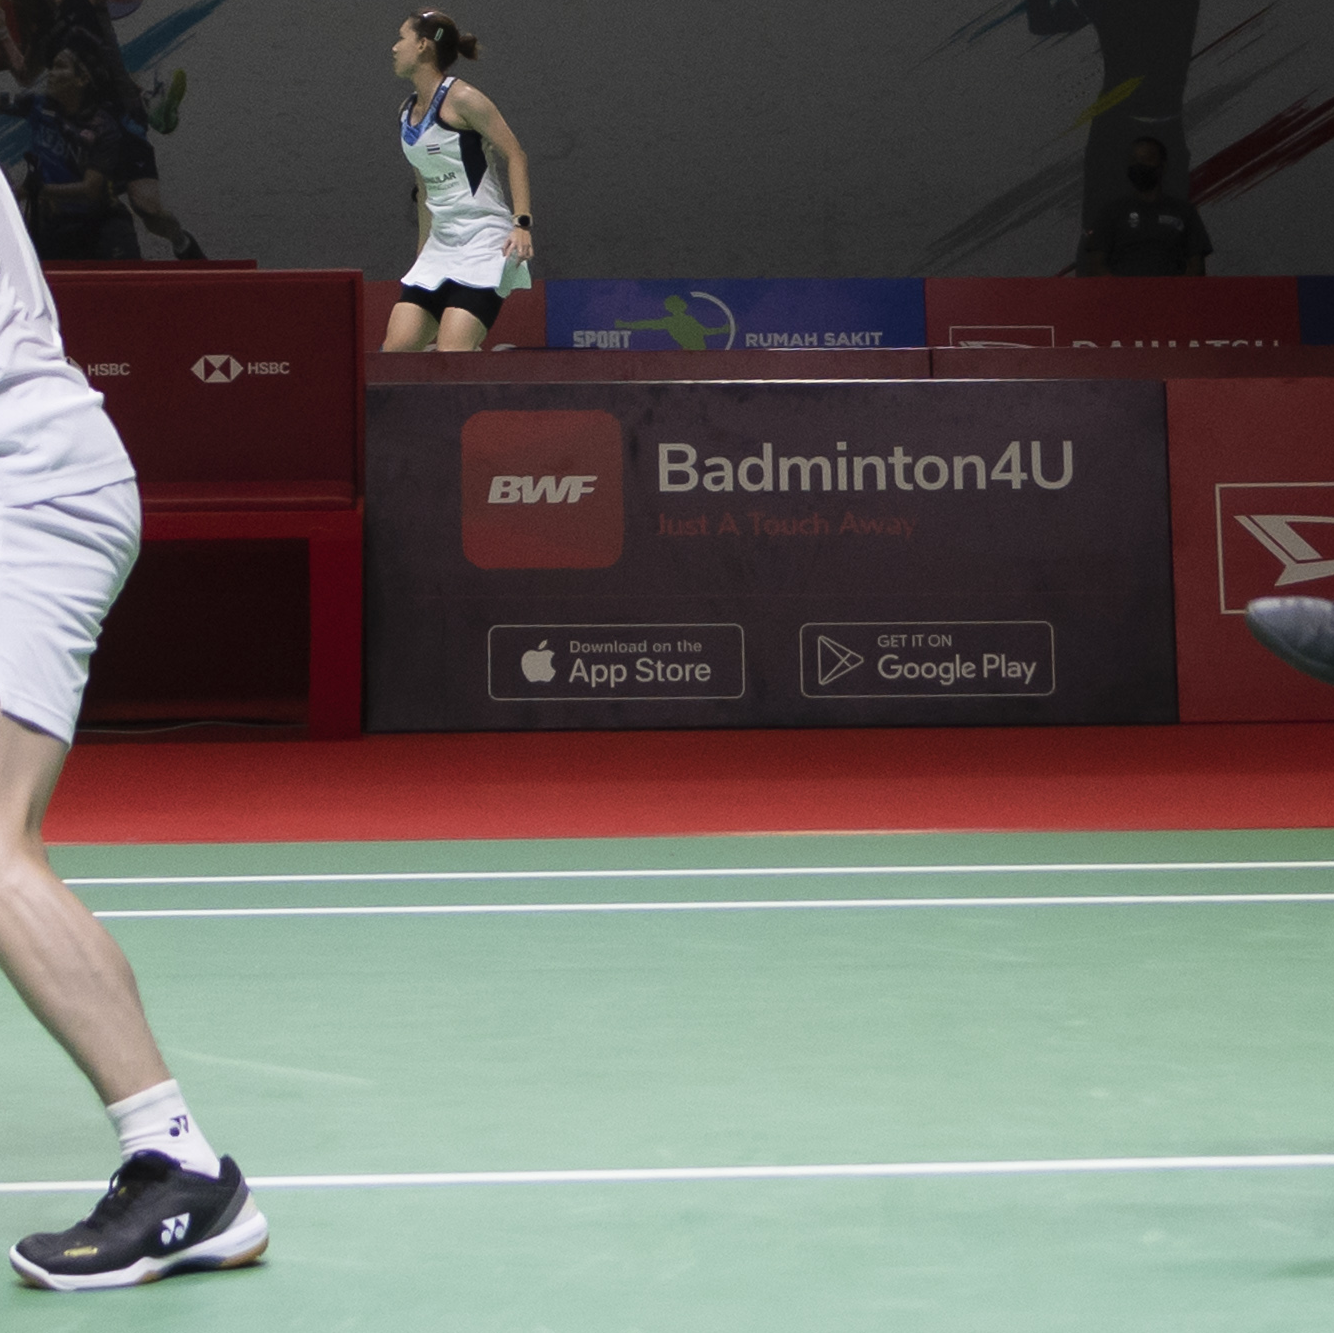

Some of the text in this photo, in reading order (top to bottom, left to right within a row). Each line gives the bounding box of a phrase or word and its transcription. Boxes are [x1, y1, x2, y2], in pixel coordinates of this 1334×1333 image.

[572, 330, 632, 348] SPORT
[745, 331, 883, 347] RUMAH SAKIT
[87, 363, 131, 377] HSBC
[247, 362, 290, 375] HSBC
[657, 441, 1074, 492] Badminton4U
[487, 475, 598, 504] BWF
[657, 512, 916, 539] Just A Touch Away
[569, 639, 703, 654] Download on the
[877, 633, 952, 648] GET IT ON
[568, 656, 712, 688] App Store
[877, 653, 1038, 686] Google Play
